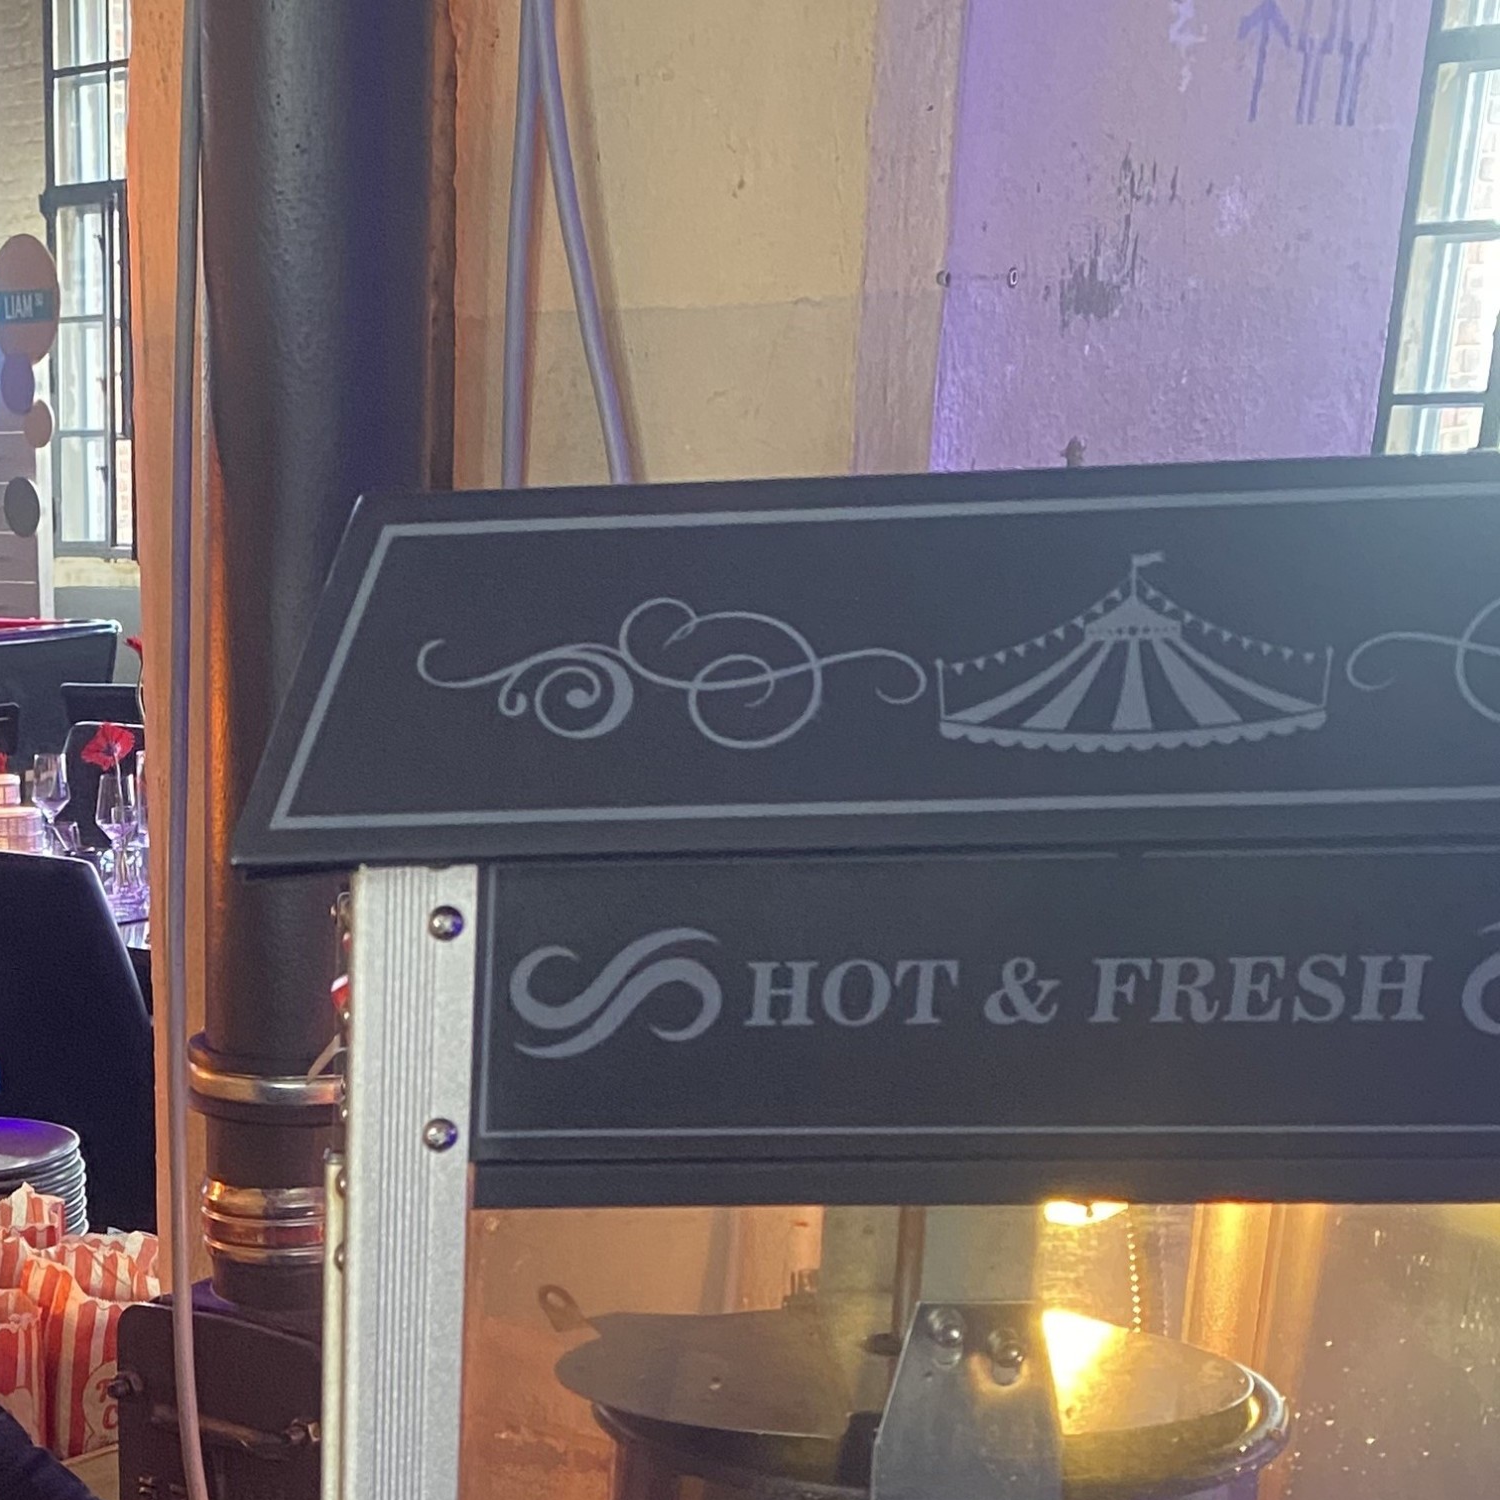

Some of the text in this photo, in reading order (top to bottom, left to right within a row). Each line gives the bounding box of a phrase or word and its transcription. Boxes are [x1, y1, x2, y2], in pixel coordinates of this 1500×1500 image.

[4, 294, 34, 319] LIAM
[743, 952, 1434, 1028] HOT & FRESH
